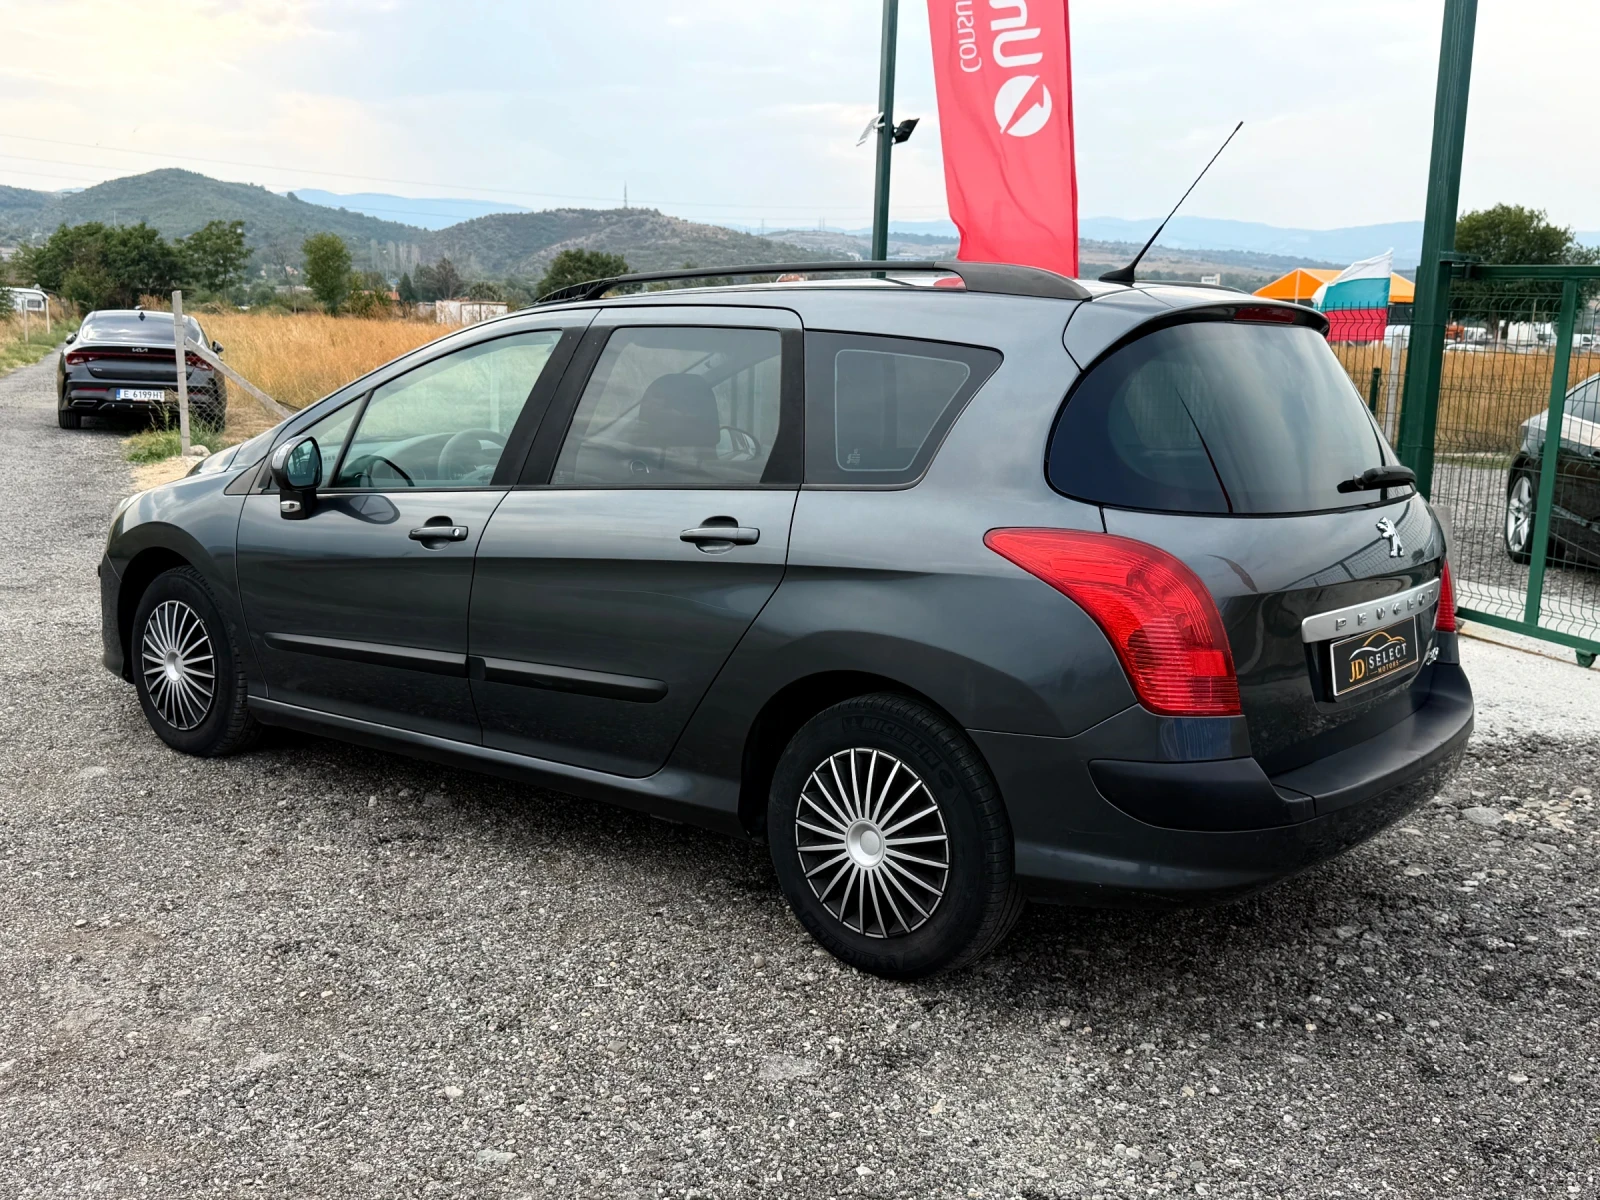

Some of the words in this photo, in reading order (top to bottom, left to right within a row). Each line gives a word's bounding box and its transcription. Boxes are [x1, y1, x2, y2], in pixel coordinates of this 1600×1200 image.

[1335, 589, 1434, 631] PEUGEOT
[1349, 659, 1365, 683] JD
[1368, 643, 1407, 669] SELECT
[1377, 660, 1399, 673] MOTORS
[861, 717, 943, 770] MICHELIN
